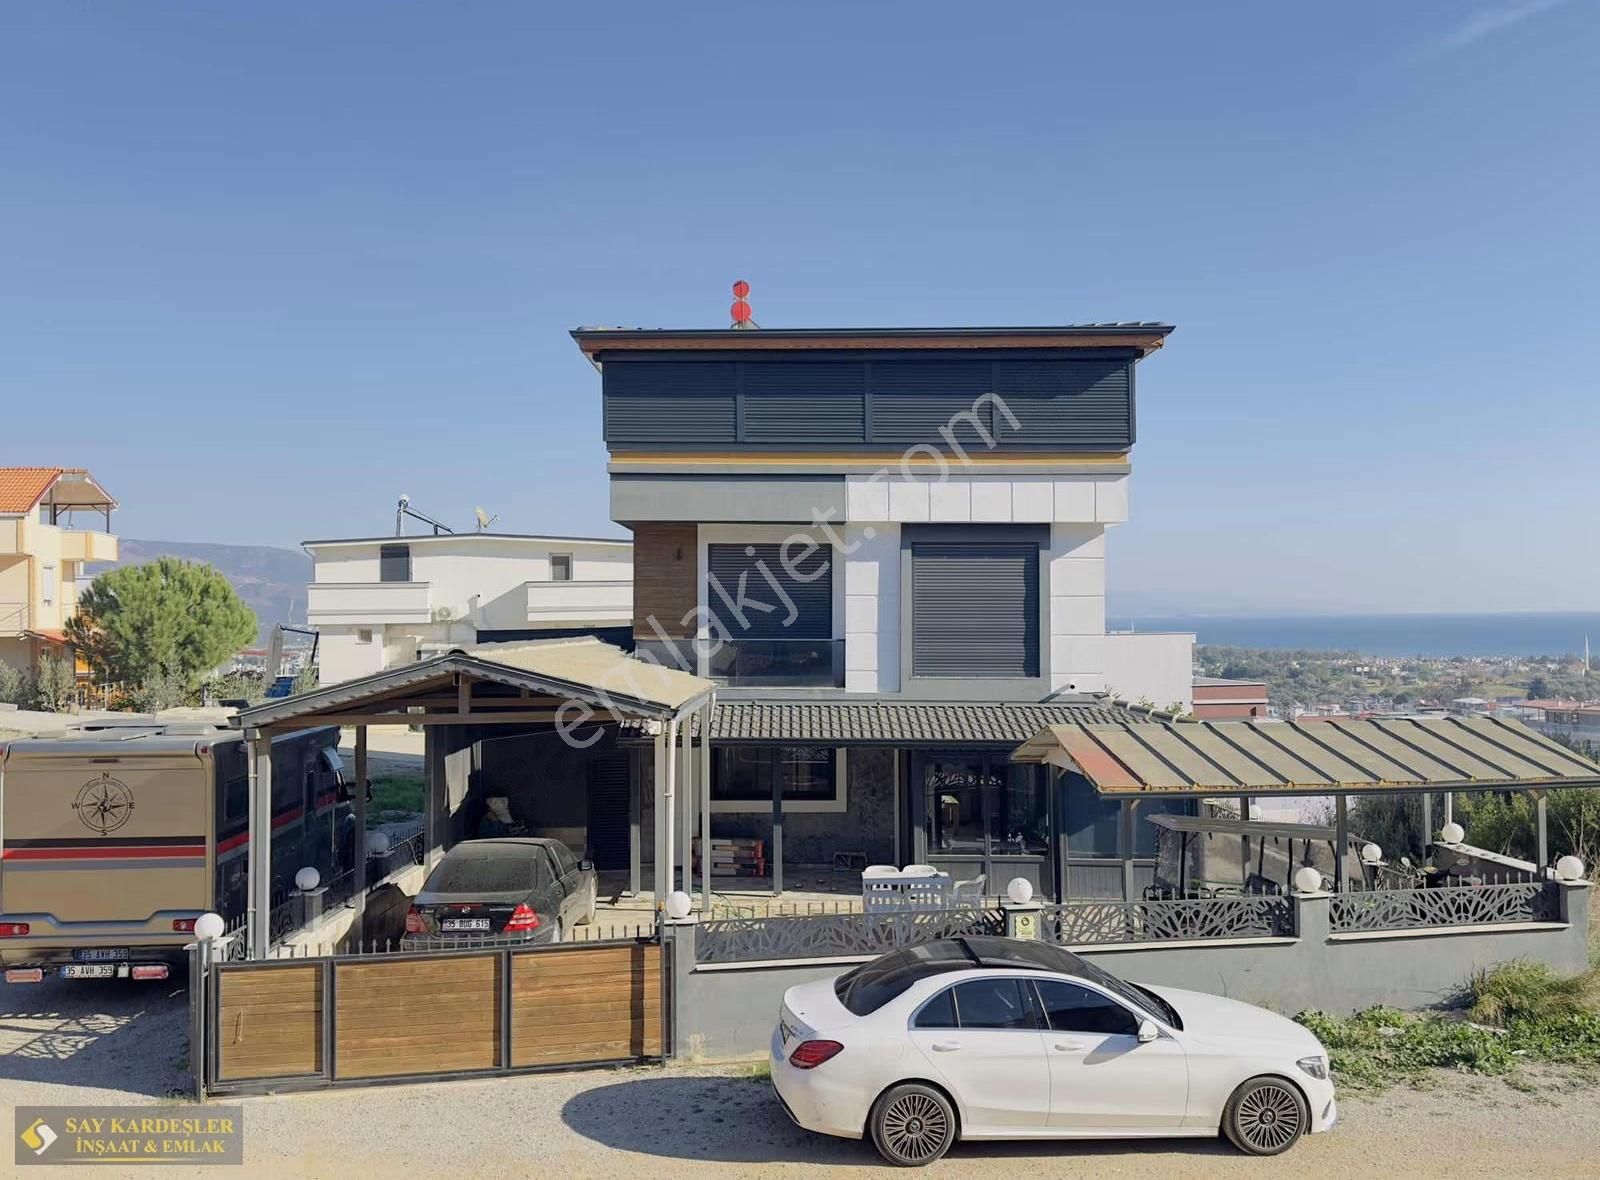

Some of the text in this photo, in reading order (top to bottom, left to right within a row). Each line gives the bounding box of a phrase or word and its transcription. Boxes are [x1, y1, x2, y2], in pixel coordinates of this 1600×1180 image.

[102, 772, 110, 780] N
[475, 919, 489, 928] 615
[66, 965, 113, 975] 35 AVH 359
